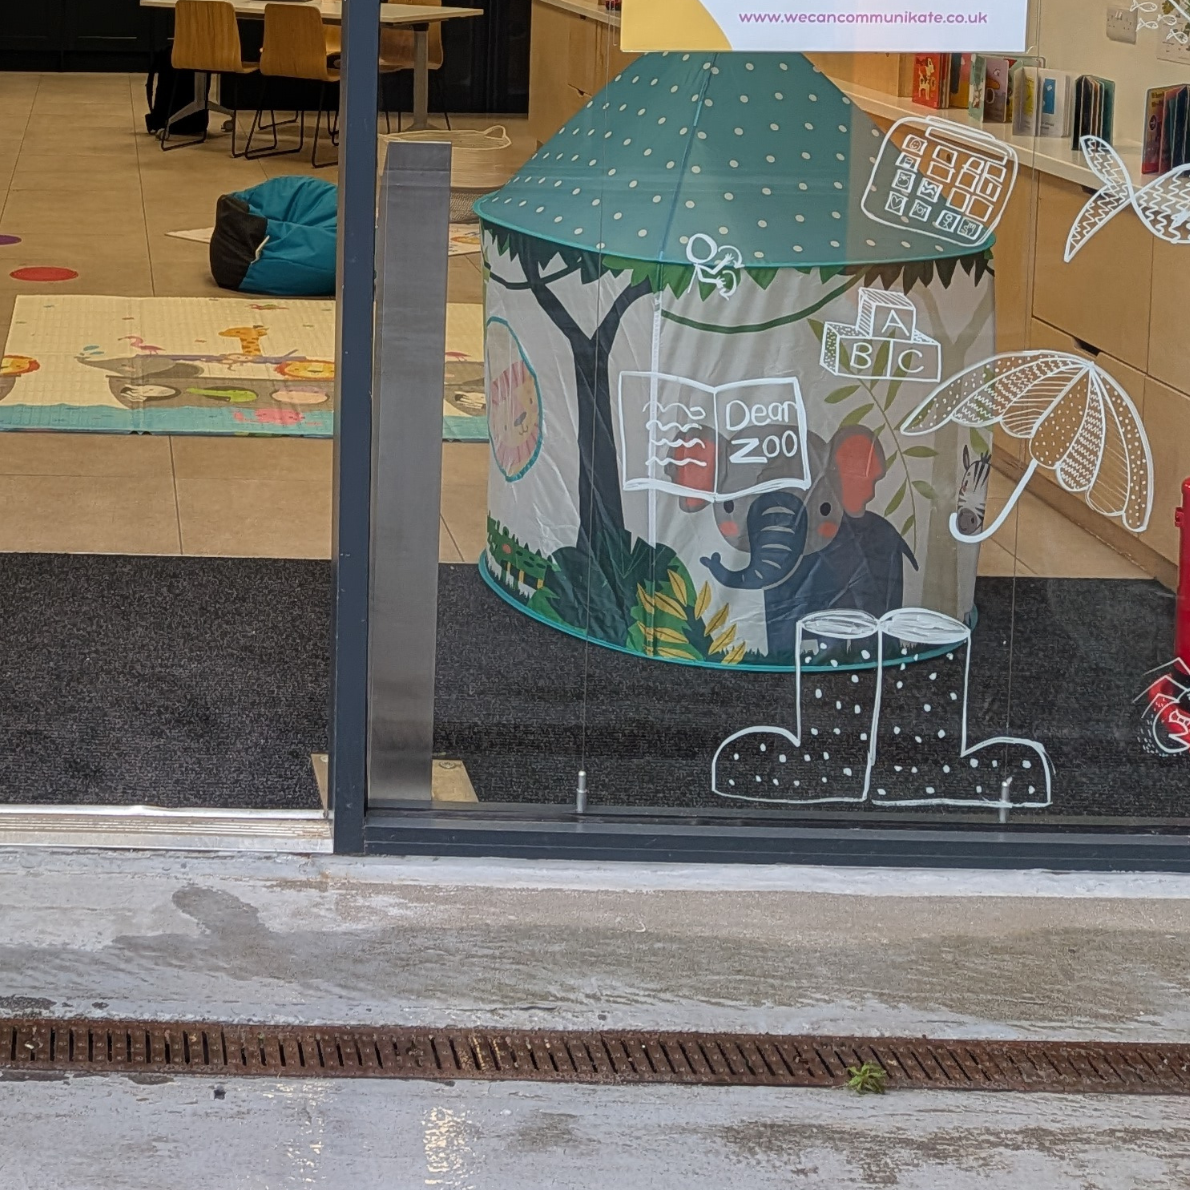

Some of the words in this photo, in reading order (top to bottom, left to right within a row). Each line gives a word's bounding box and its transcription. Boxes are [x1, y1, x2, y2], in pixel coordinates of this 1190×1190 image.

[739, 11, 988, 24] www.wecancommunikate.co.uk
[881, 310, 910, 337] A
[850, 342, 872, 370] B
[898, 349, 925, 373] C
[725, 399, 798, 431] Dear
